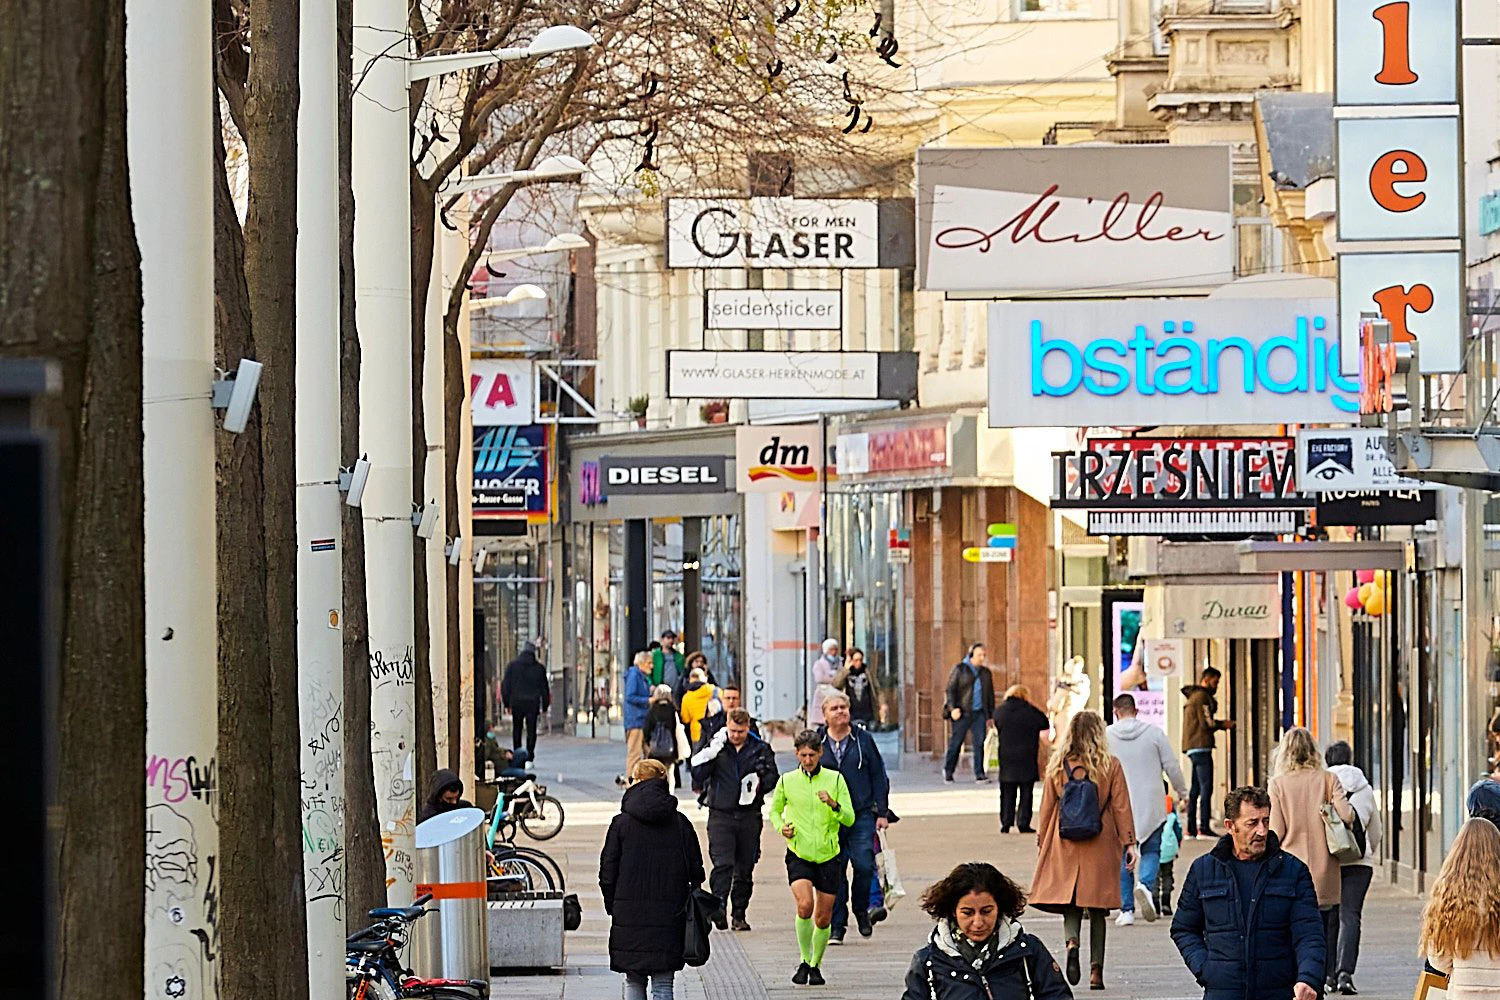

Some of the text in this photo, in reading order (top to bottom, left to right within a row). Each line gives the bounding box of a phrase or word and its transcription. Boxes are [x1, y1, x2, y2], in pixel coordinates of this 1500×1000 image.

[792, 216, 856, 227] FOR MEN
[936, 184, 1225, 252] Miller
[691, 207, 854, 258] GLASER
[712, 296, 834, 317] seidensticker
[760, 437, 808, 465] dm
[608, 466, 718, 485] DIESEL
